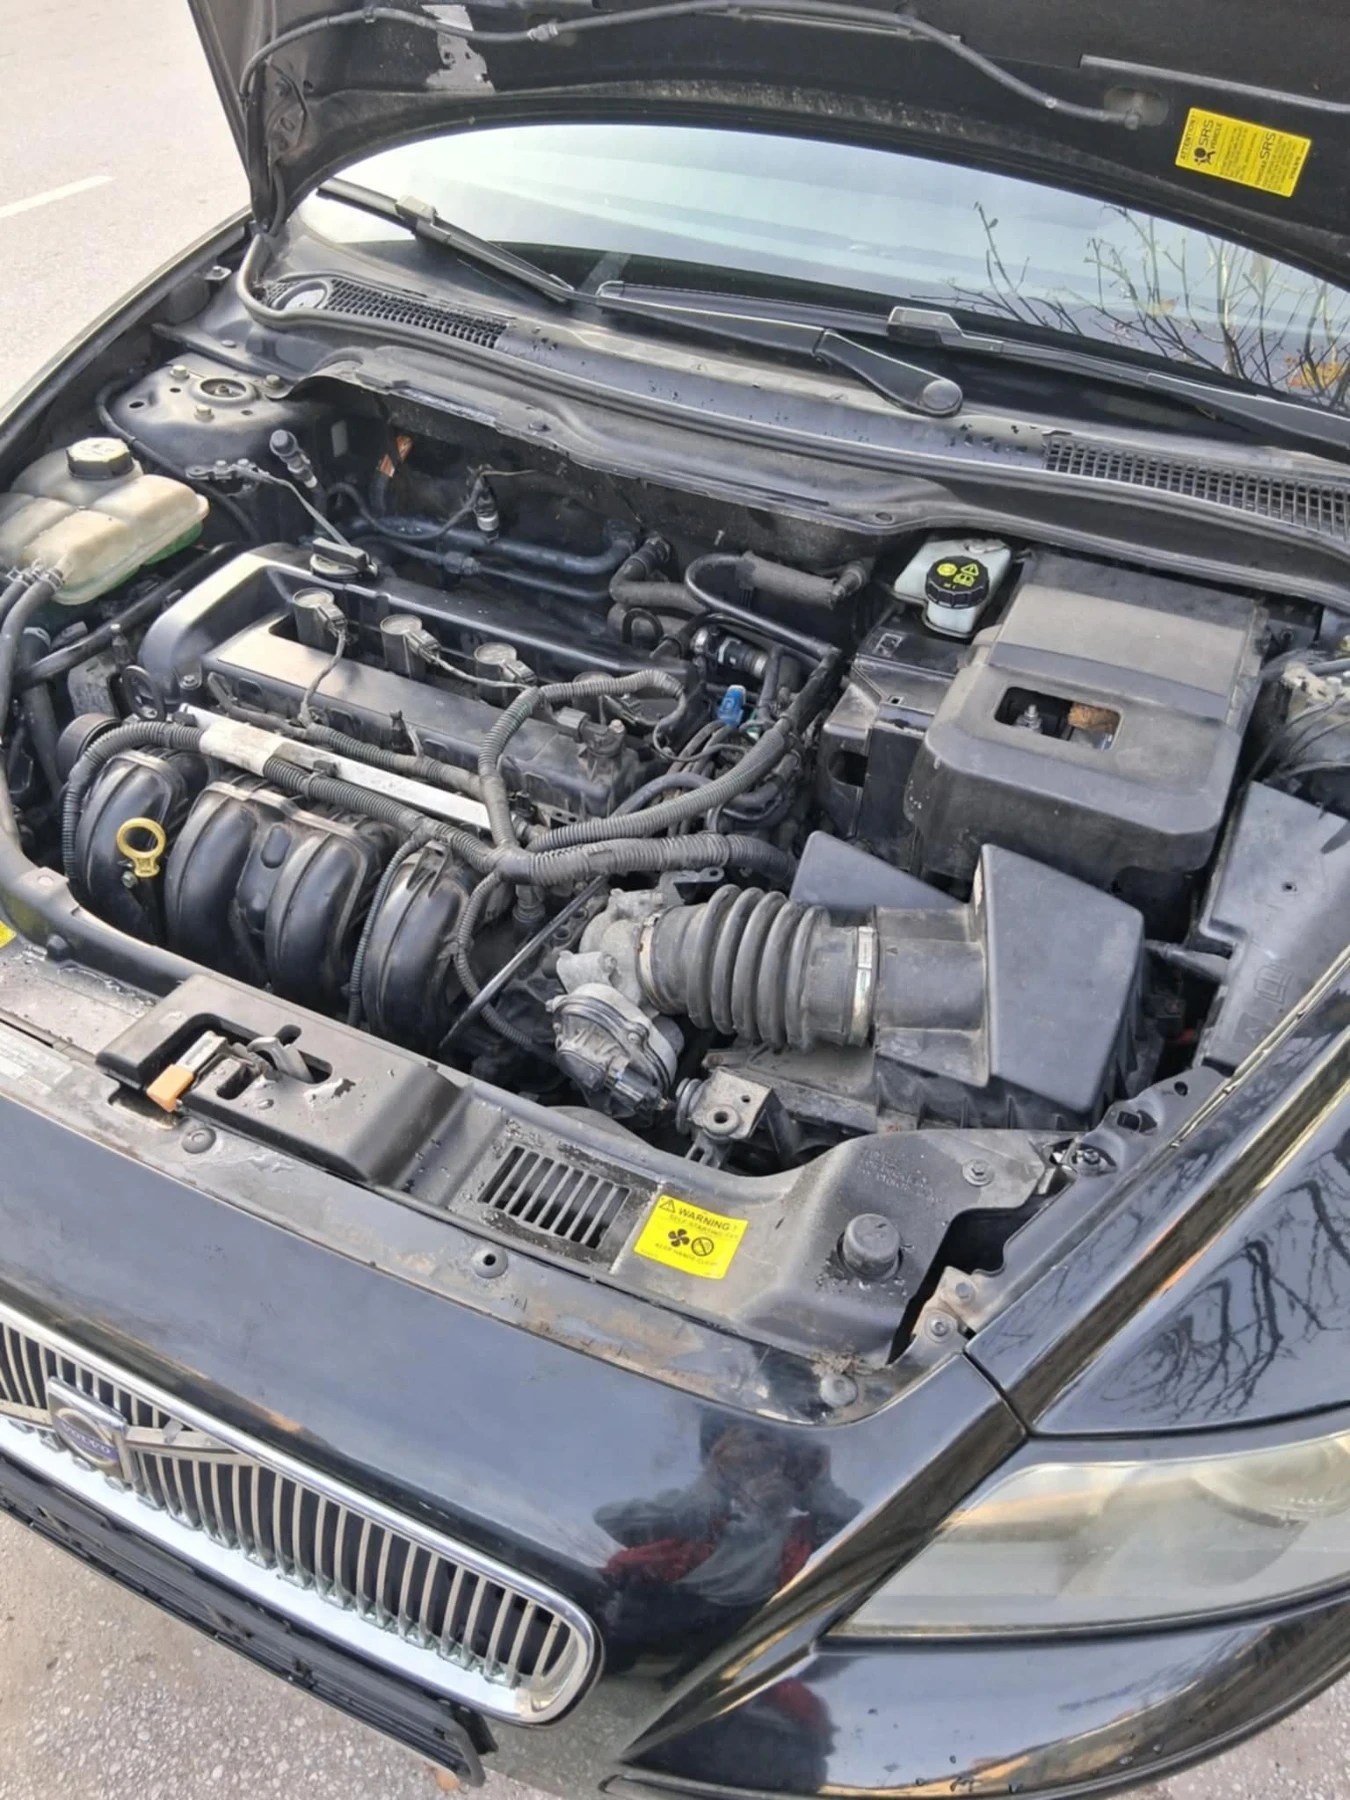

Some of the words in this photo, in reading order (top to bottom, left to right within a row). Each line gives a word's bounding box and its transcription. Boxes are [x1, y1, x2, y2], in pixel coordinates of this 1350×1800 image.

[1200, 119, 1214, 146] SRS
[1260, 132, 1276, 160] SRS
[678, 1207, 730, 1231] WARNING
